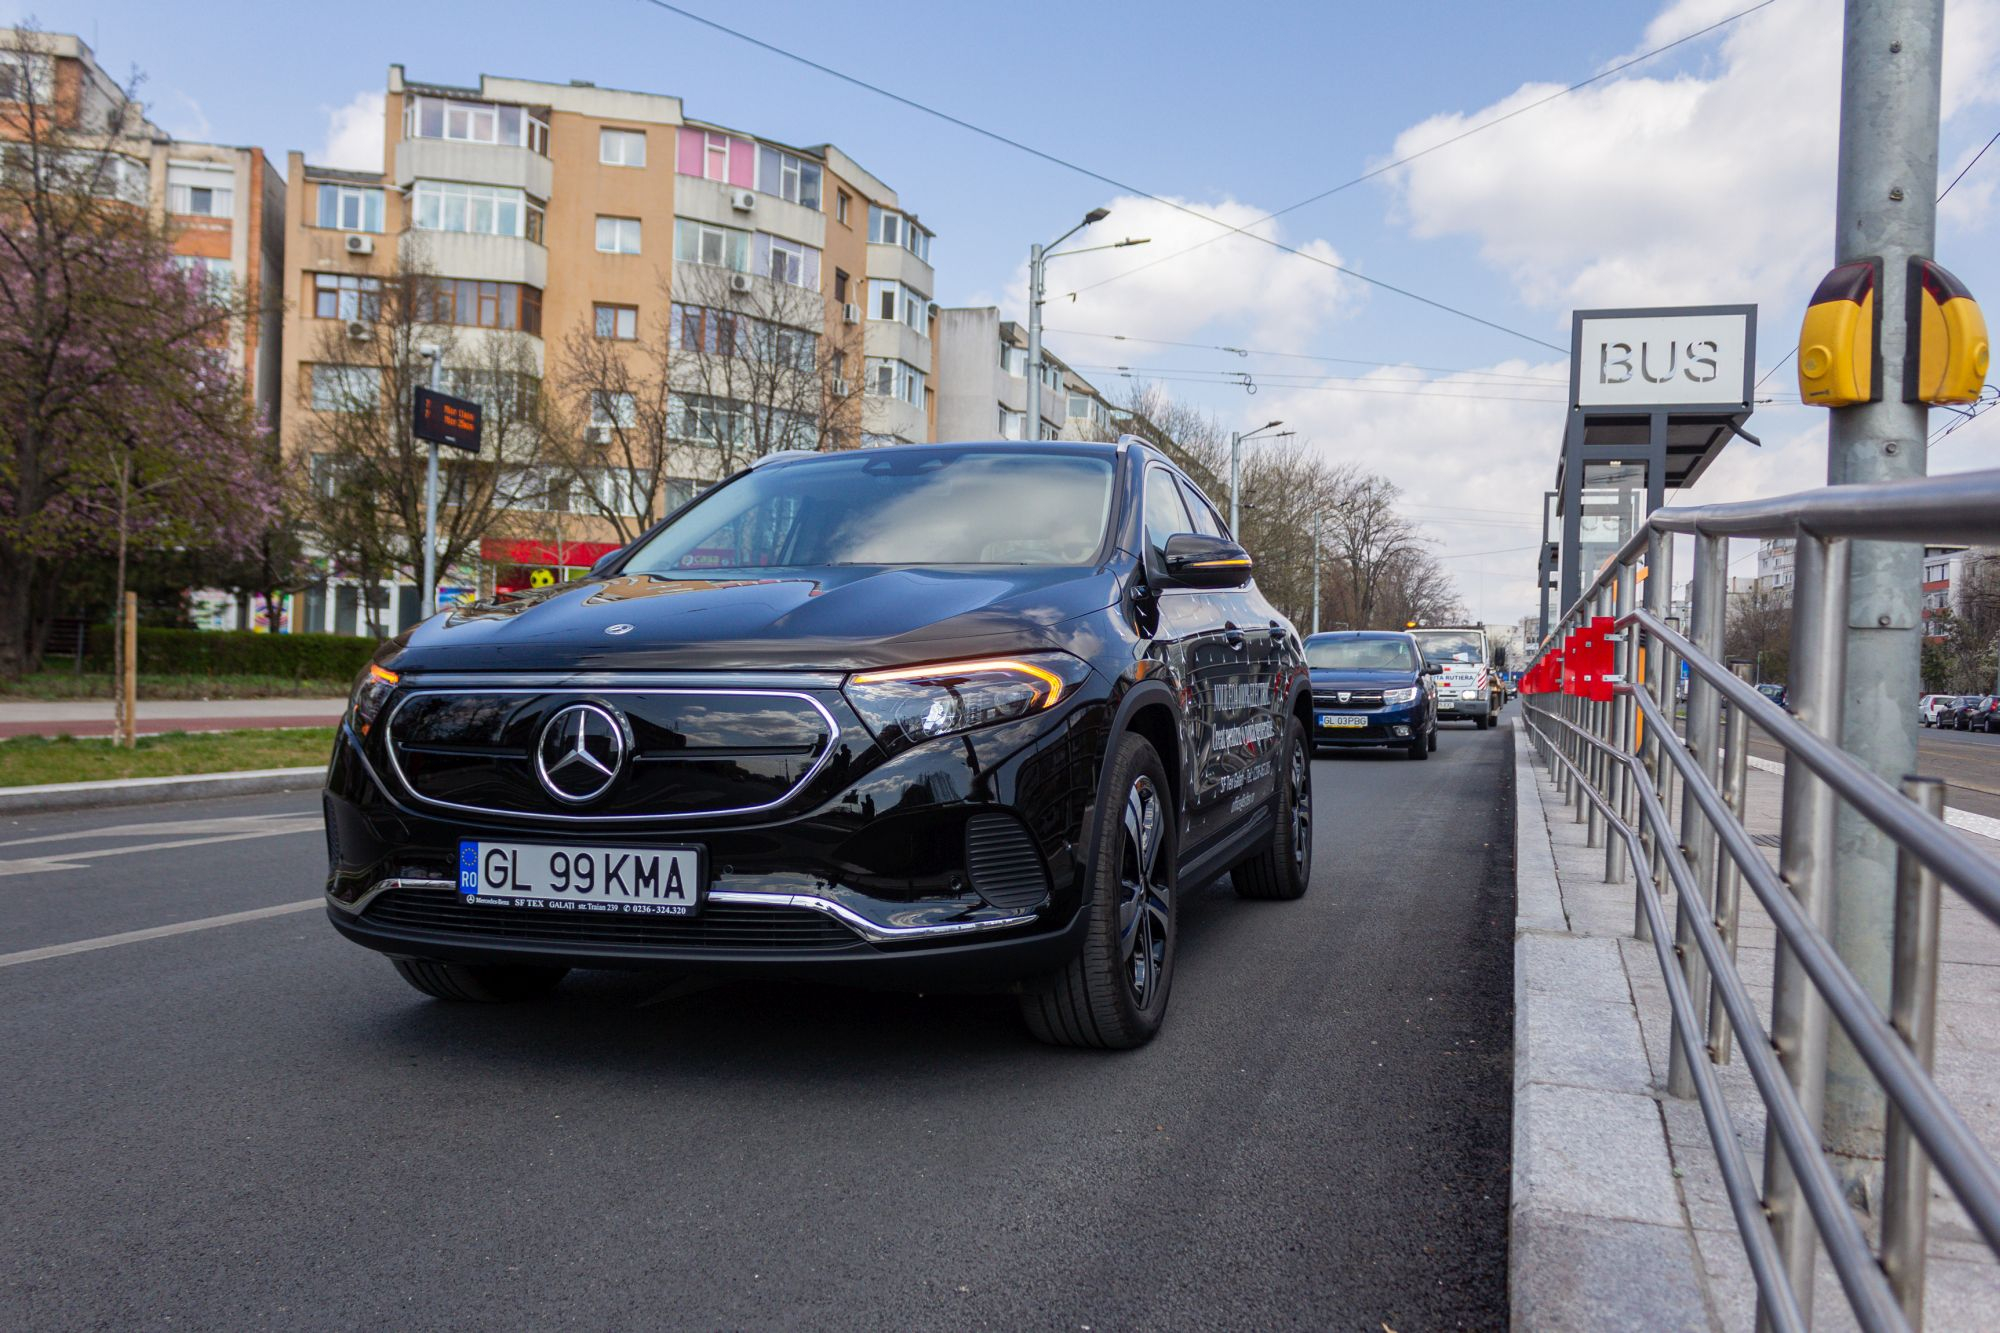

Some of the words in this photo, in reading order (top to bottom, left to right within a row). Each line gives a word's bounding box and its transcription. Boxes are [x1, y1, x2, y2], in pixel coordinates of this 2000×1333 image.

[1600, 341, 1718, 384] BUS
[461, 871, 477, 888] RO
[484, 848, 532, 891] GL
[527, 899, 545, 908] TEX
